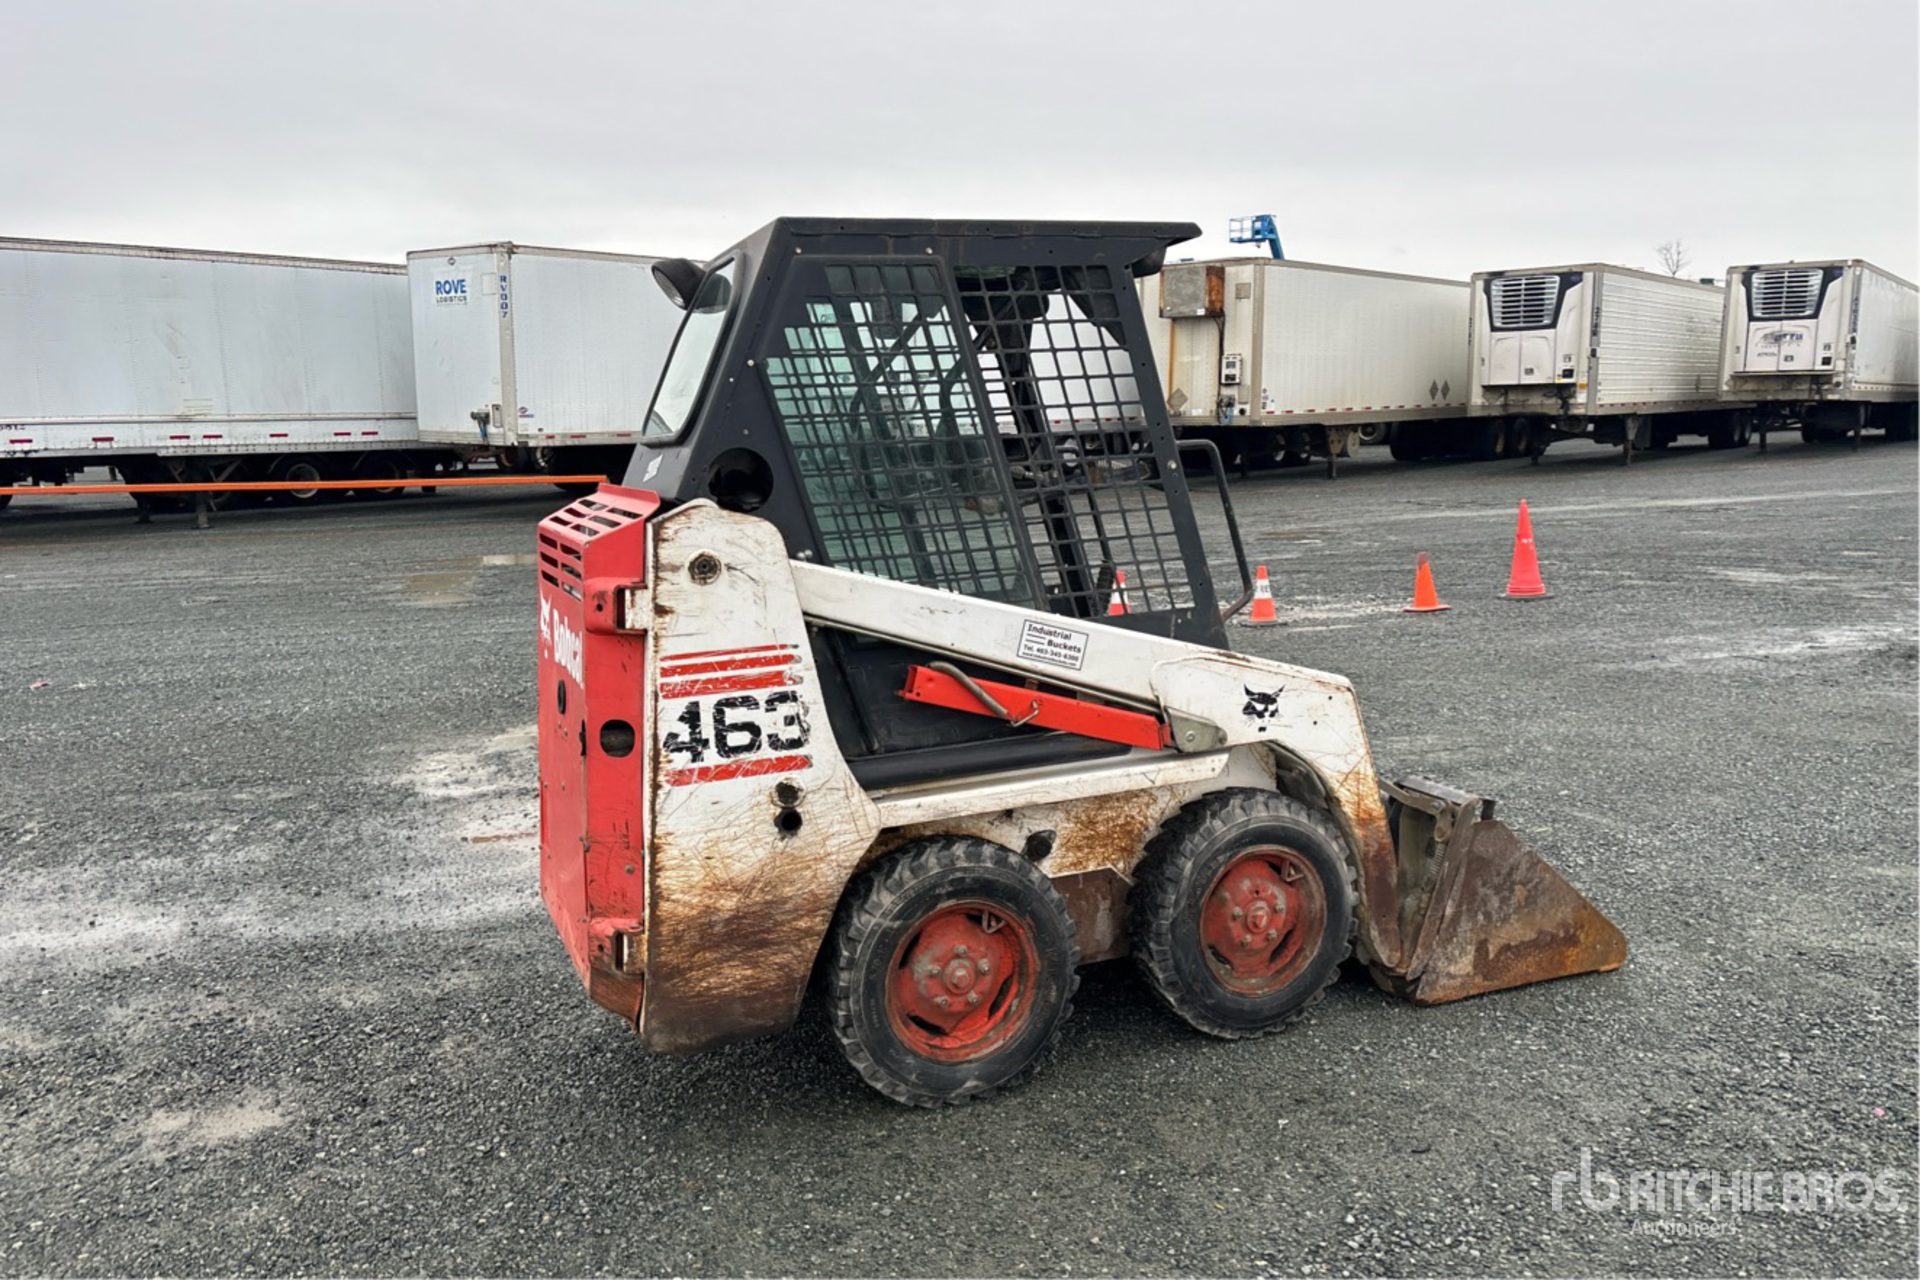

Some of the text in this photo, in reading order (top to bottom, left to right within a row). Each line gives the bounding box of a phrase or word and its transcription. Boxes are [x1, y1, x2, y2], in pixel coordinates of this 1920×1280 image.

[435, 279, 467, 295] ROVE
[499, 275, 509, 318] RV007
[1028, 624, 1072, 640] Industrial
[1047, 639, 1081, 653] Buckets
[662, 690, 811, 764] 463
